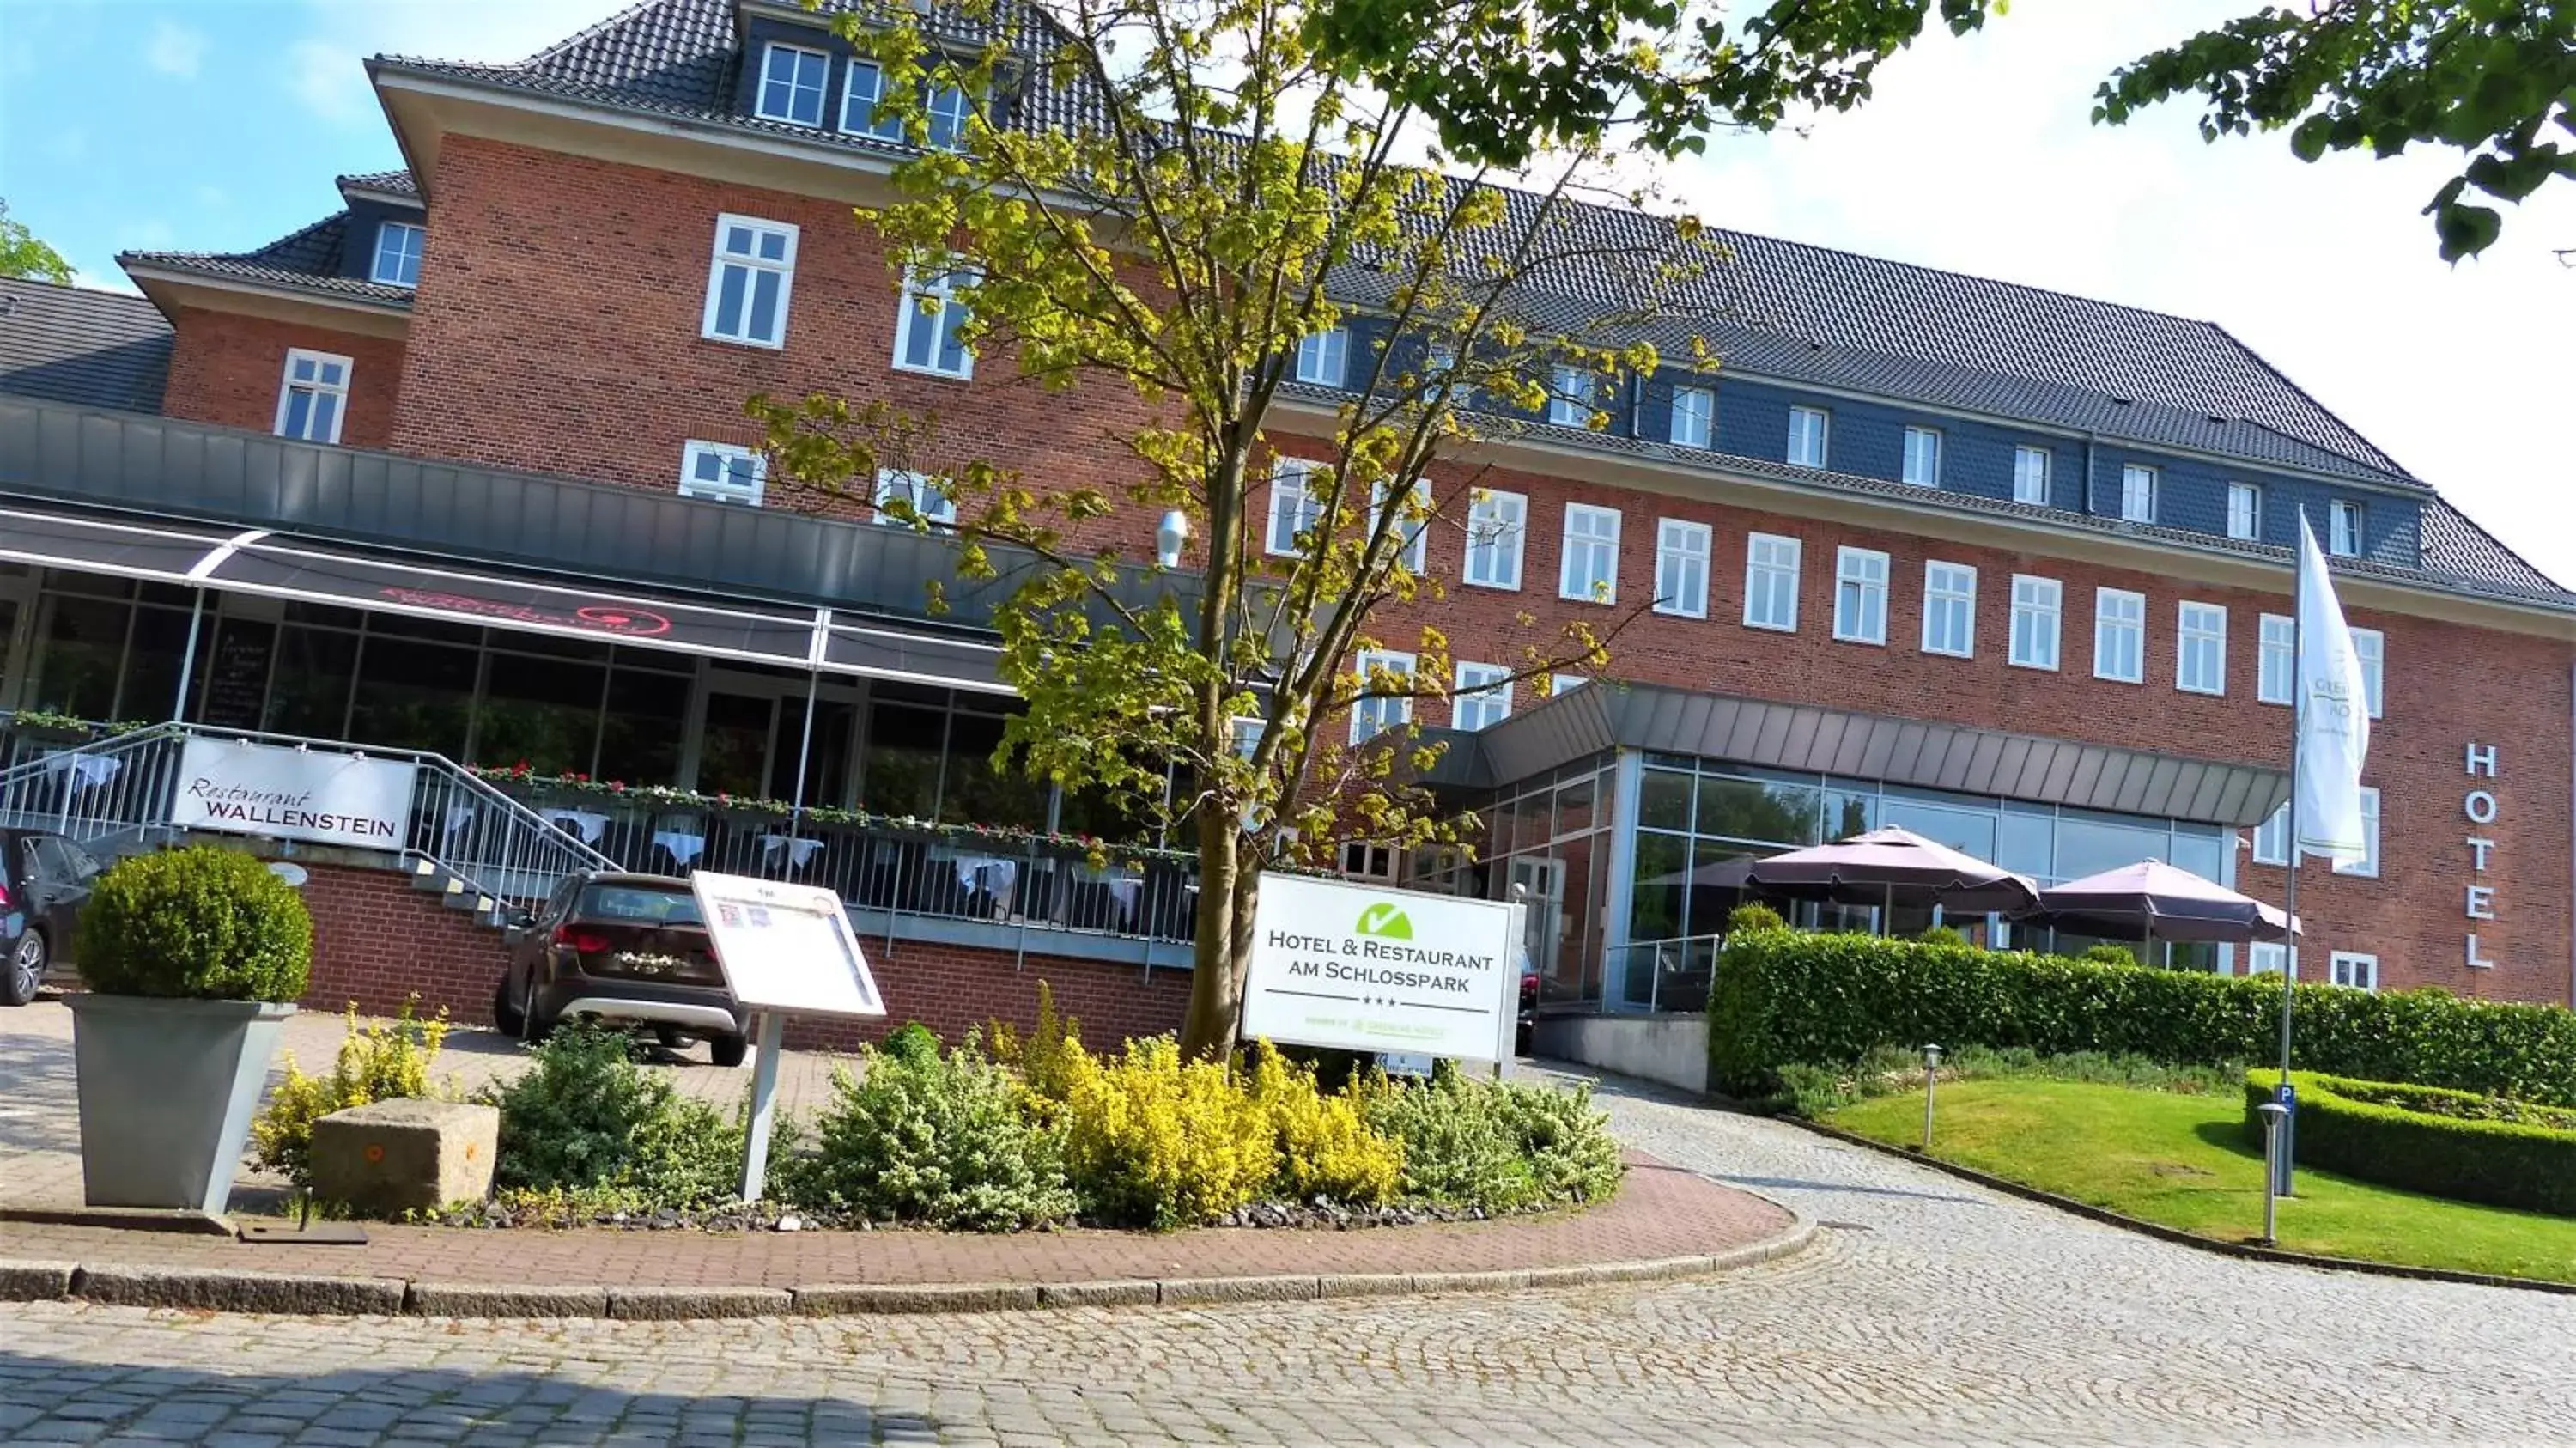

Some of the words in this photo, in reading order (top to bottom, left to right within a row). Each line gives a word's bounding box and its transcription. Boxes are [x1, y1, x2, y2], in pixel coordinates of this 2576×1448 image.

[188, 777, 310, 807] Restaurant
[206, 800, 395, 837] WALLENSTEIN
[2465, 743, 2496, 968] HOTEL
[1268, 930, 1337, 954] HOTEL
[1341, 939, 1358, 957] &
[1363, 940, 1494, 970] RESTAURANT
[1288, 959, 1320, 977] AM
[1324, 961, 1470, 993] SCHLOSSPARK
[2281, 1086, 2292, 1102] P
